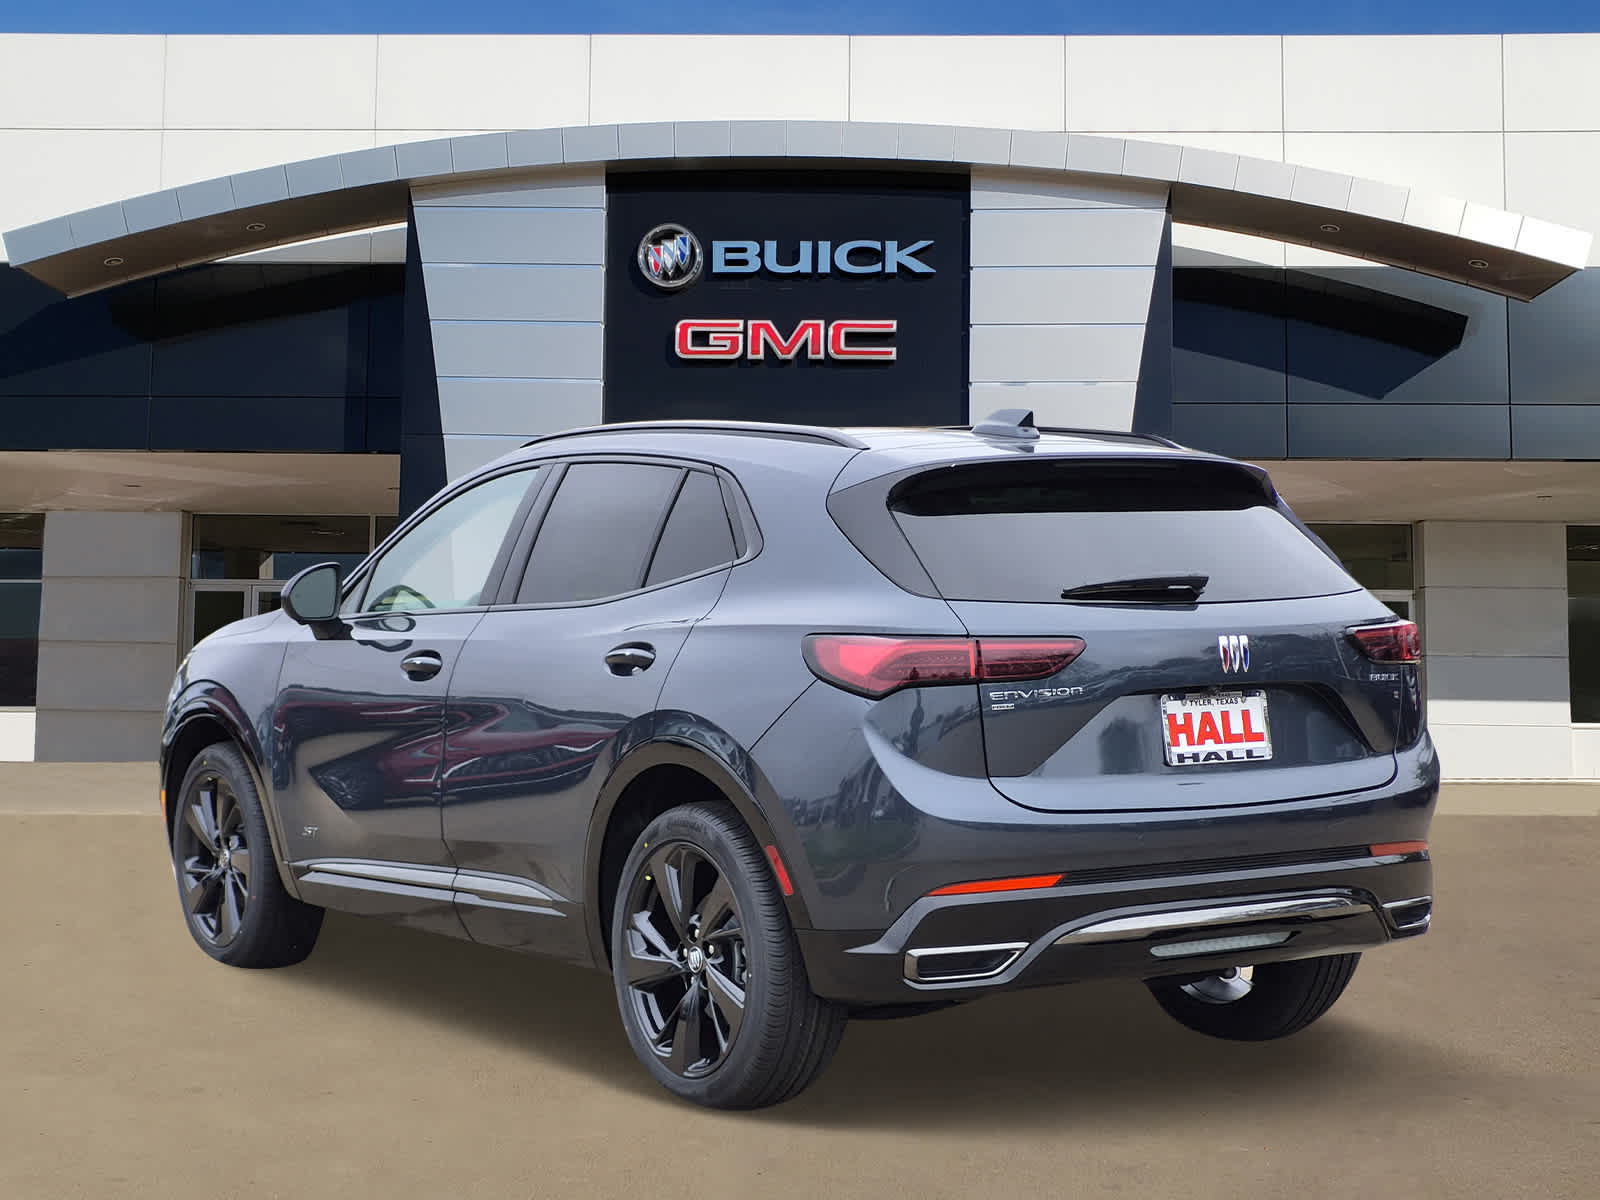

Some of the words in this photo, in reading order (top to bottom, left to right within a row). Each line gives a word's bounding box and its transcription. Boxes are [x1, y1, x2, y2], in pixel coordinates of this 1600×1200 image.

[712, 240, 937, 274] BUICK
[675, 319, 898, 360] GMC
[989, 686, 1084, 701] ENVISION
[1189, 697, 1215, 707] TYLER,
[1216, 696, 1239, 706] TEXAS
[1167, 709, 1265, 747] HALL
[1177, 749, 1265, 764] HALL
